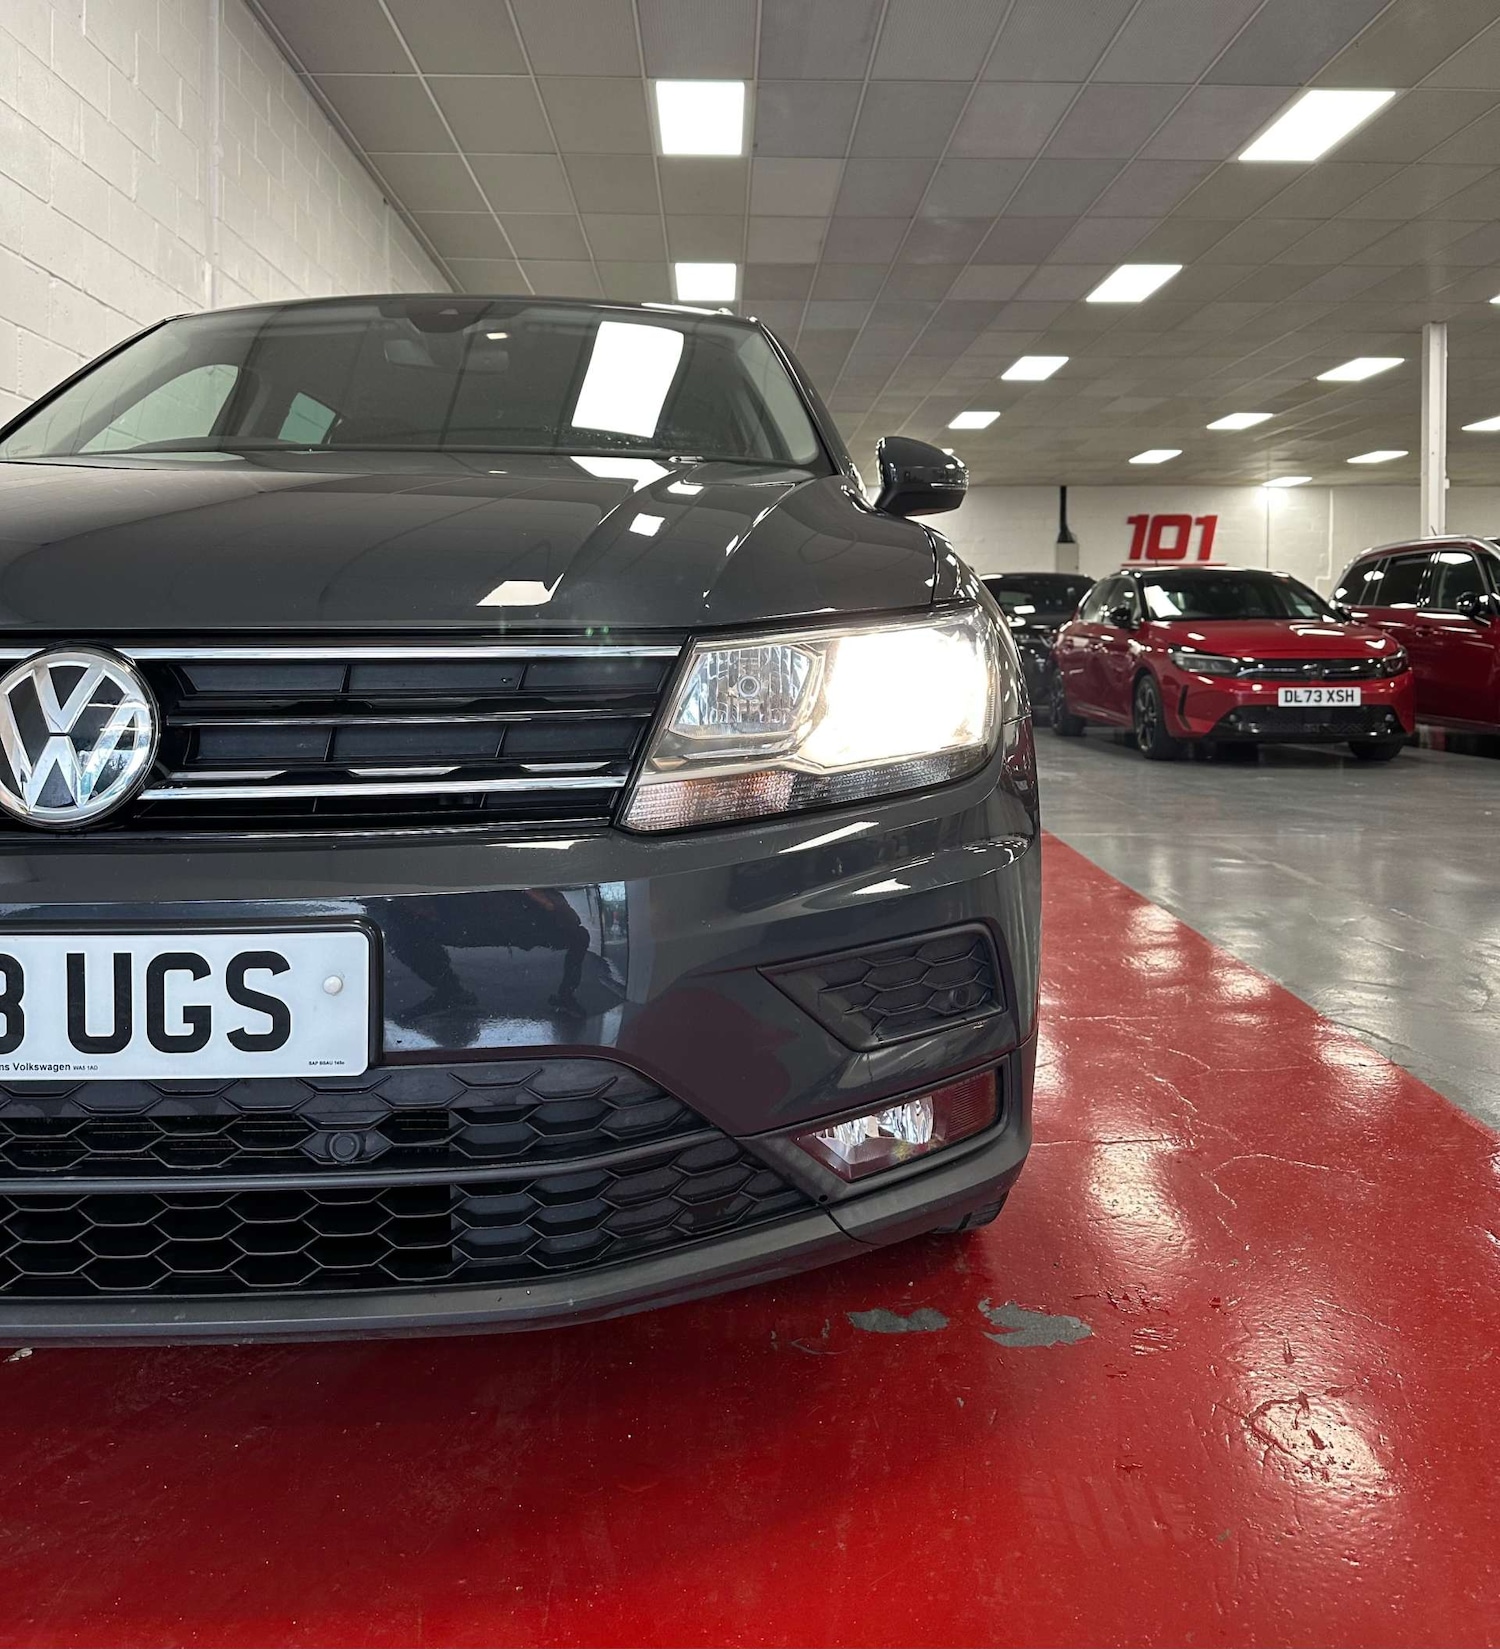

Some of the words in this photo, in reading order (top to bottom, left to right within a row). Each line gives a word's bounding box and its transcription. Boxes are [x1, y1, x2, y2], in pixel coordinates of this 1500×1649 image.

[1126, 514, 1218, 561] 101
[1284, 690, 1322, 703] DL73
[1326, 690, 1354, 703] XSH
[66, 950, 291, 1054] UGS
[12, 1062, 71, 1073] Volkswagen
